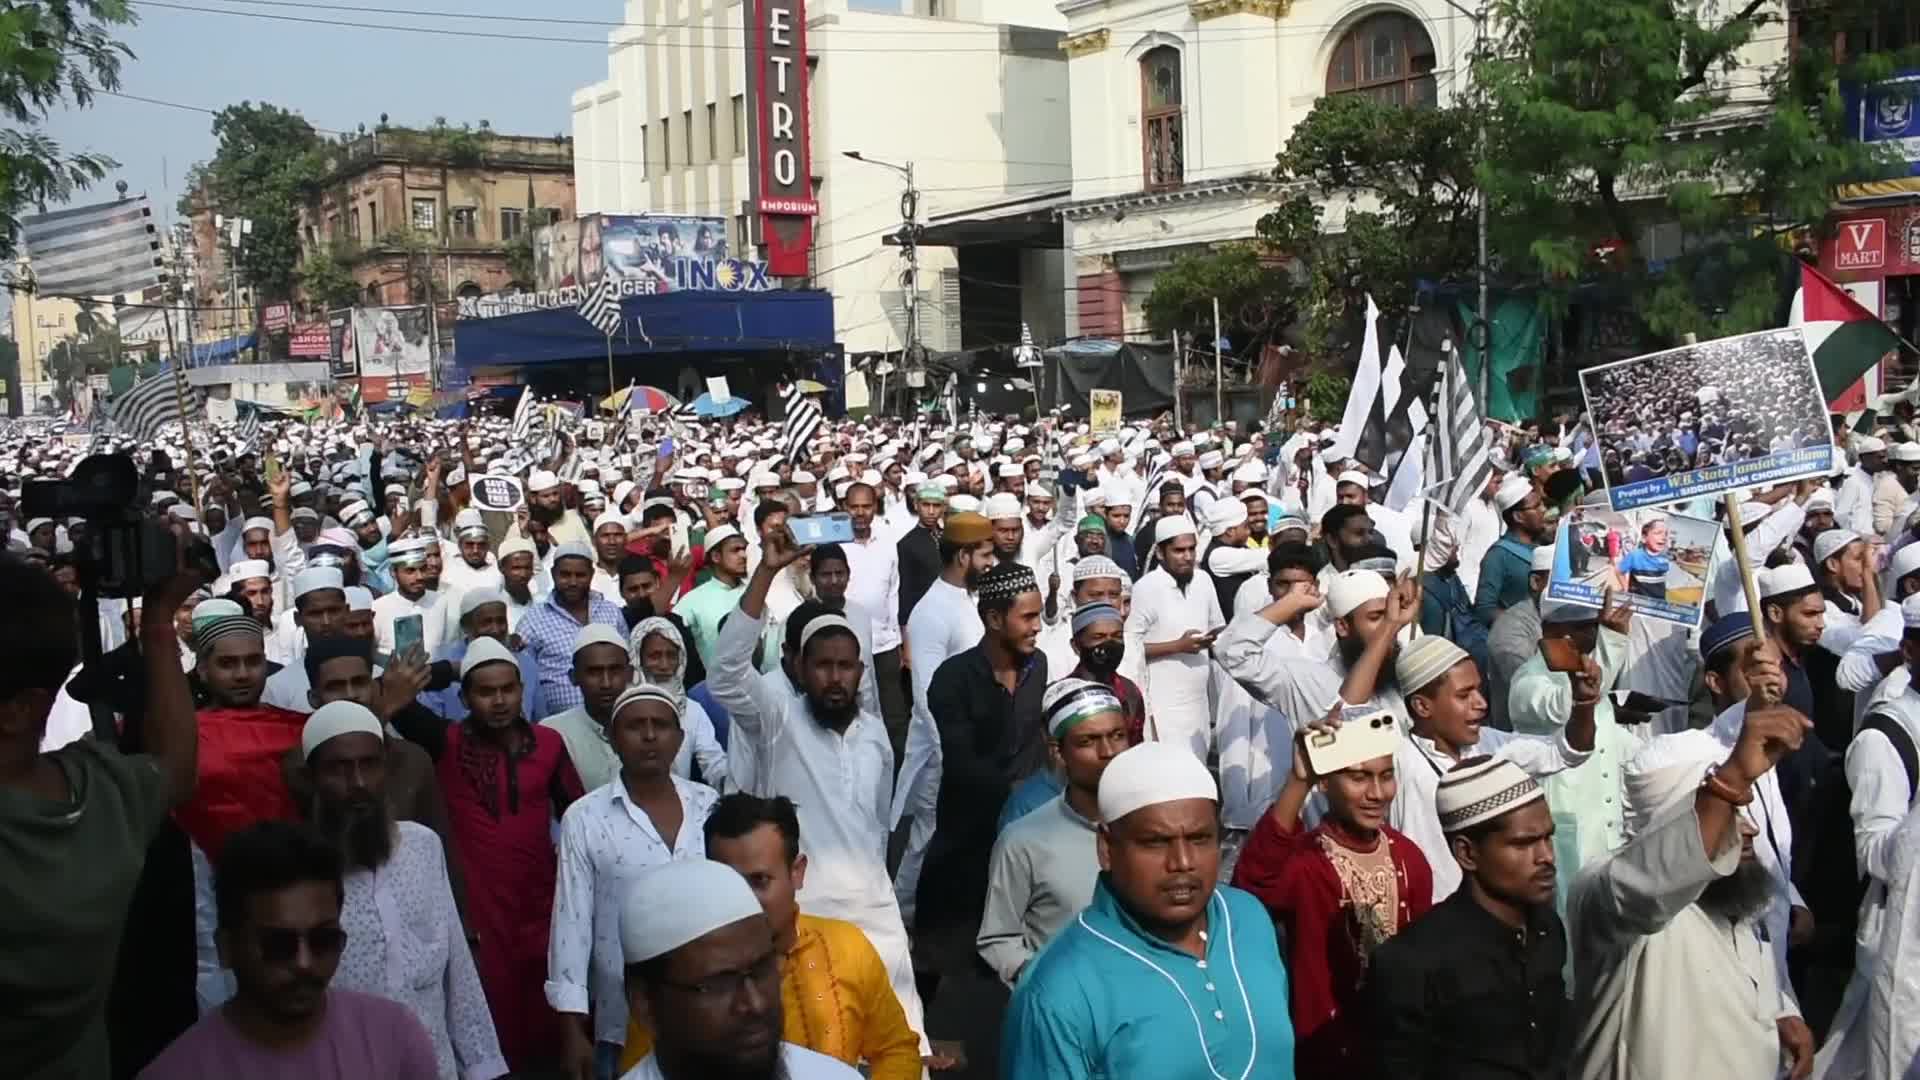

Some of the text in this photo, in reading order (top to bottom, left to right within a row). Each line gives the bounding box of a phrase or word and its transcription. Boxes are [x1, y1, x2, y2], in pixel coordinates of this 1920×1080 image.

[761, 200, 817, 212] EMPORIUM
[1848, 224, 1873, 250] V
[1840, 250, 1880, 265] MART
[675, 256, 769, 291] INOX
[484, 479, 508, 488] SAVE
[1650, 484, 1661, 494] by
[1697, 467, 1730, 481] State
